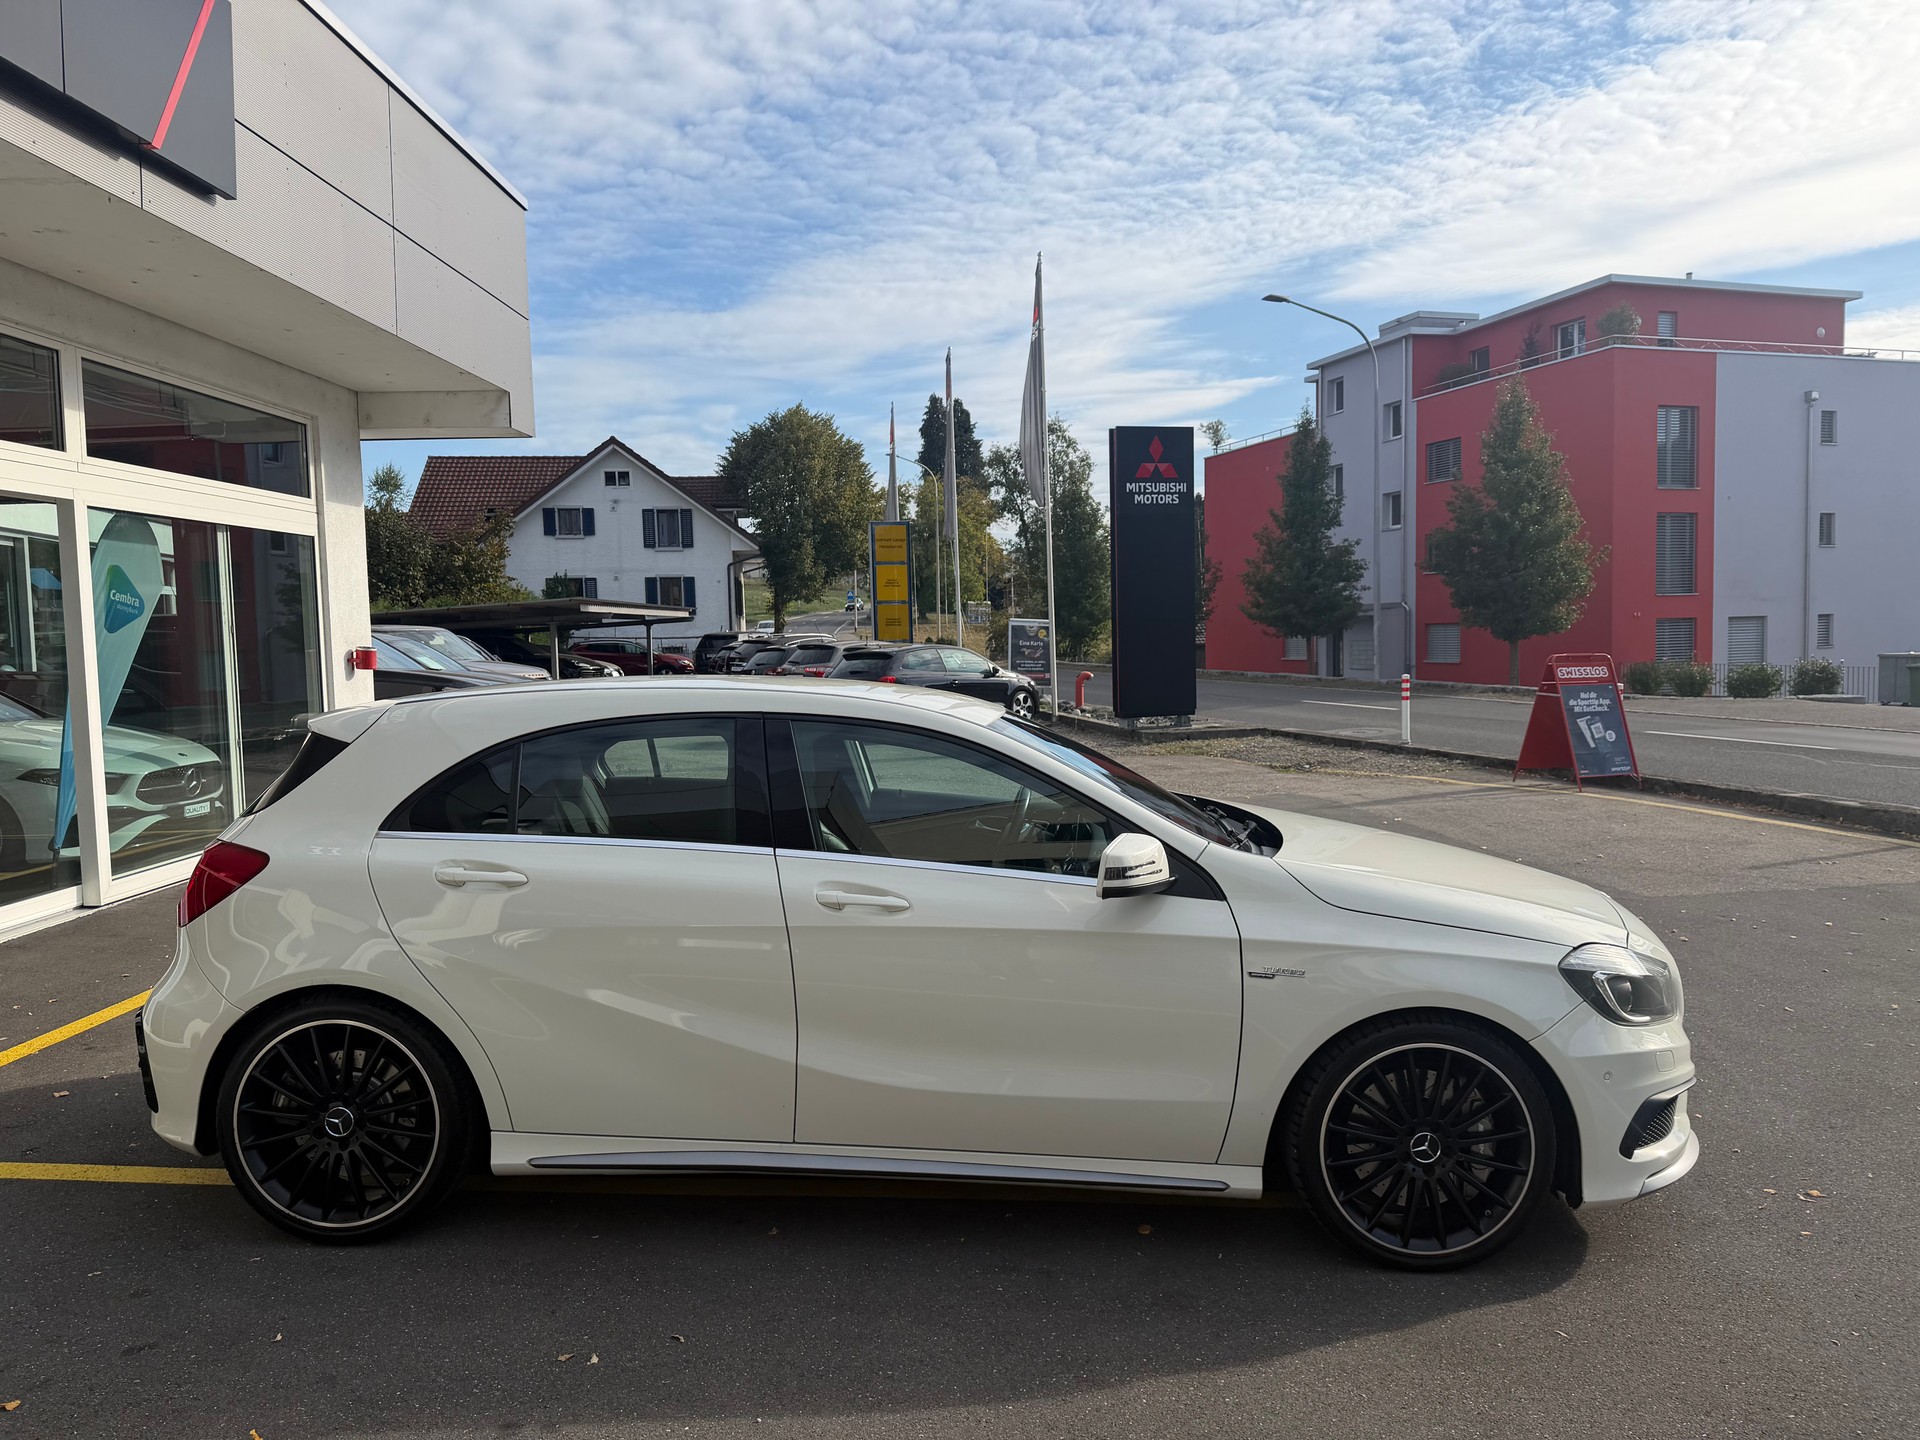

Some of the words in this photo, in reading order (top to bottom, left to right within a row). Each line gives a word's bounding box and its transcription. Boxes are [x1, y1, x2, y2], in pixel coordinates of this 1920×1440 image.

[1126, 482, 1187, 493] MITSUBISHI
[1134, 494, 1180, 504] MOTORS
[110, 589, 140, 607] Cembra
[1558, 667, 1608, 678] SWISSLOS
